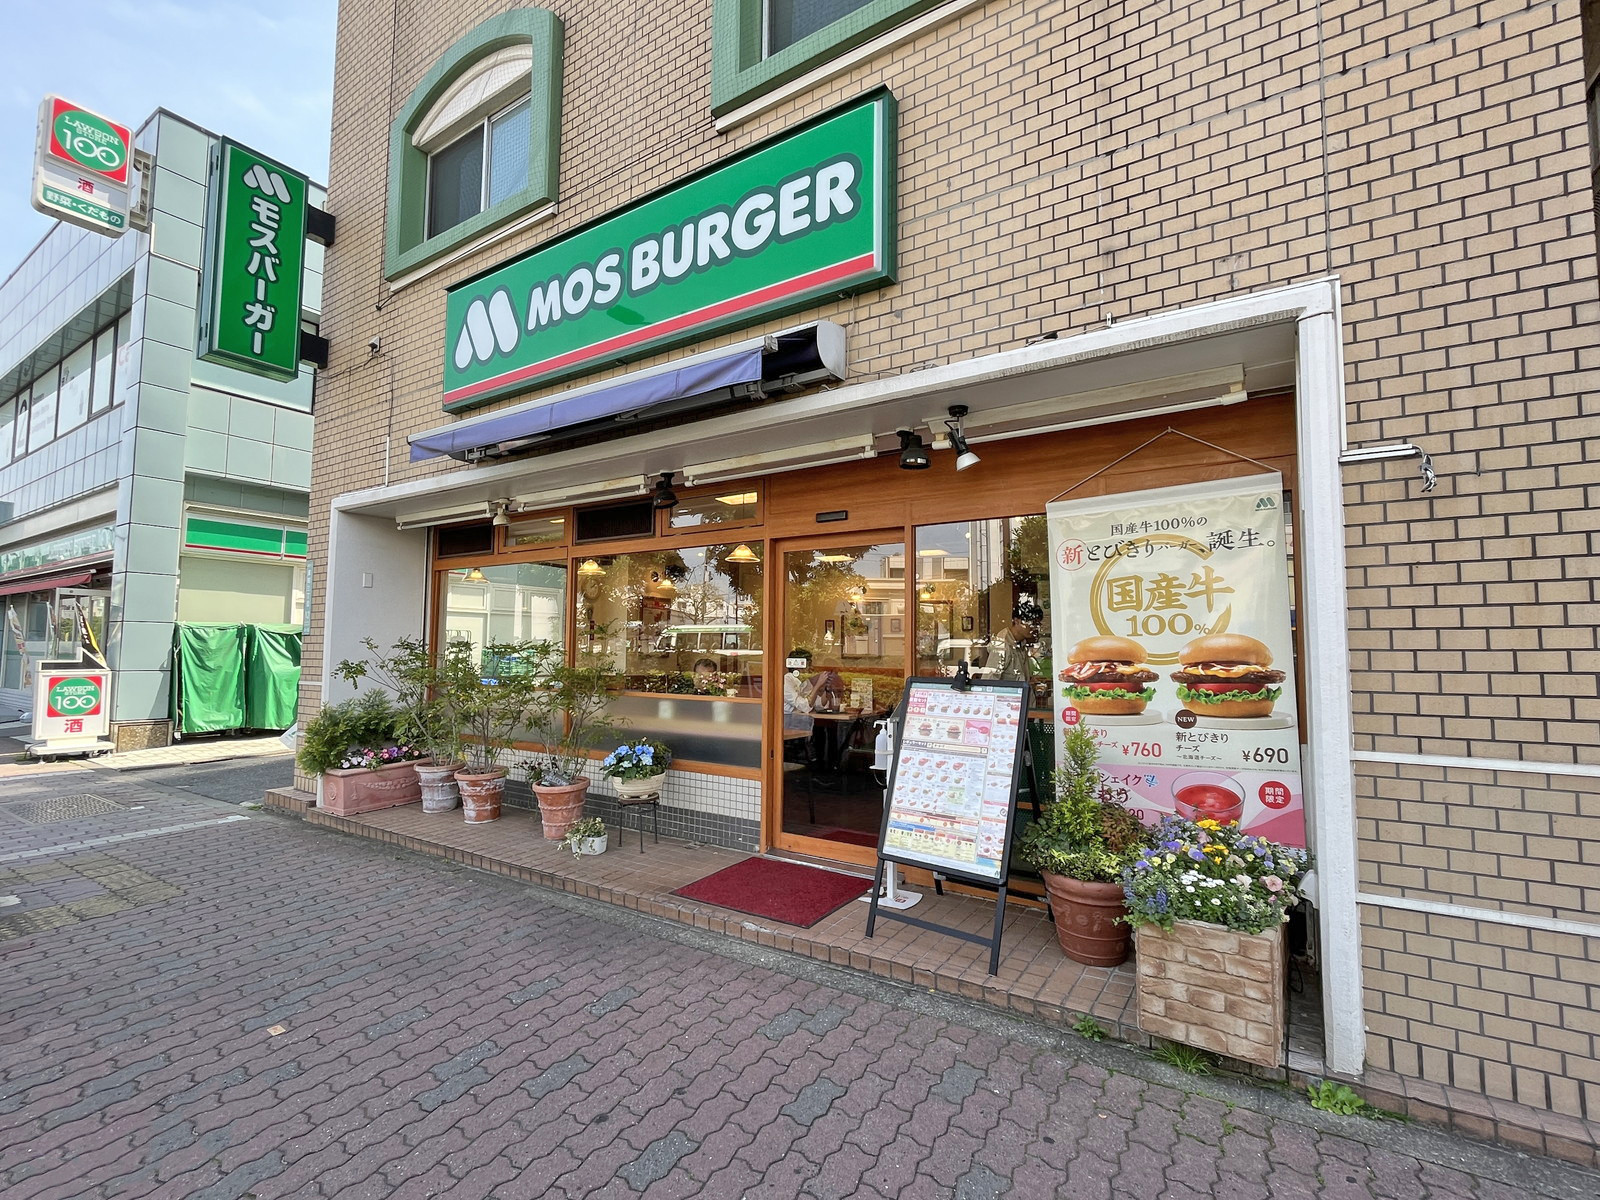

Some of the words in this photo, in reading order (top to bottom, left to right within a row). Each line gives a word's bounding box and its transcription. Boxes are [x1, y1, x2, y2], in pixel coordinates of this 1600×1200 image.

[64, 115, 119, 146] LAWSON
[63, 128, 120, 167] 100
[77, 177, 95, 195] 酒
[46, 190, 121, 225] 野菜・くだもの
[527, 252, 622, 331] MOS
[631, 161, 856, 292] BURGER
[244, 196, 281, 355] モスバーガー
[1110, 516, 1208, 537] 国産牛100%の
[1106, 565, 1236, 614] 国産牛
[1125, 613, 1212, 637] 100%
[56, 685, 95, 693] LAWSON
[55, 695, 96, 710] 100
[64, 718, 84, 733] 酒
[1175, 731, 1229, 744] 新とびきり
[1122, 741, 1162, 758] ¥760
[1175, 744, 1200, 753] チーズ
[1241, 747, 1289, 764] ¥690
[1264, 786, 1285, 796] 期間
[1265, 795, 1285, 804] 限定
